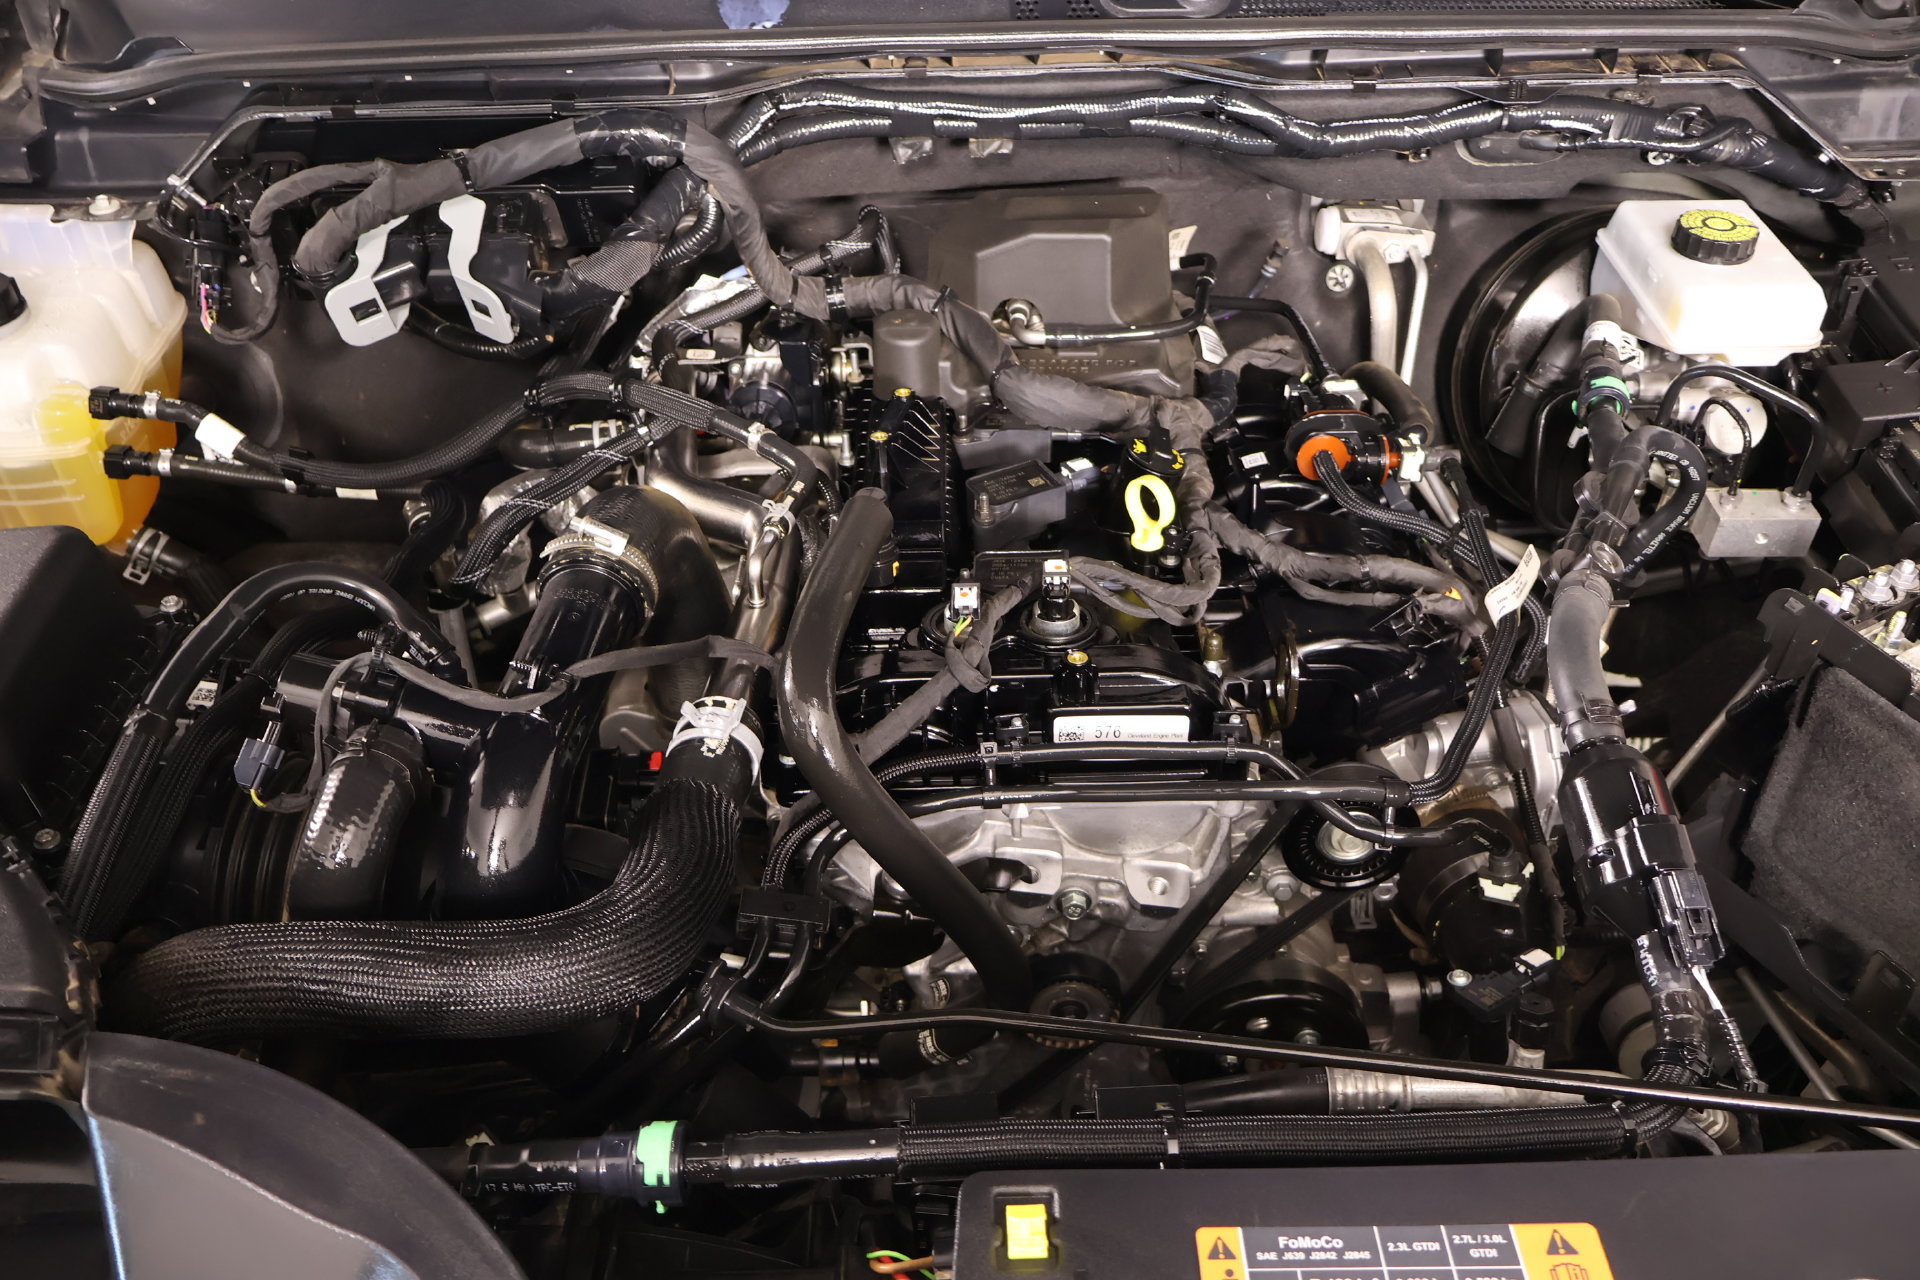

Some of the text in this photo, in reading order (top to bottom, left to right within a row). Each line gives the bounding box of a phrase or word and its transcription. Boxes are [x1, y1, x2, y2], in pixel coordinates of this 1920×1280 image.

[1094, 725, 1122, 739] 576
[1278, 1236, 1344, 1249] FoMoCo
[1452, 1235, 1477, 1244] 2.7L
[1484, 1234, 1508, 1244] 3.0L
[1387, 1242, 1440, 1252] 2.3L GTDI
[1256, 1252, 1278, 1260] SAE
[1469, 1248, 1498, 1258] GTDI
